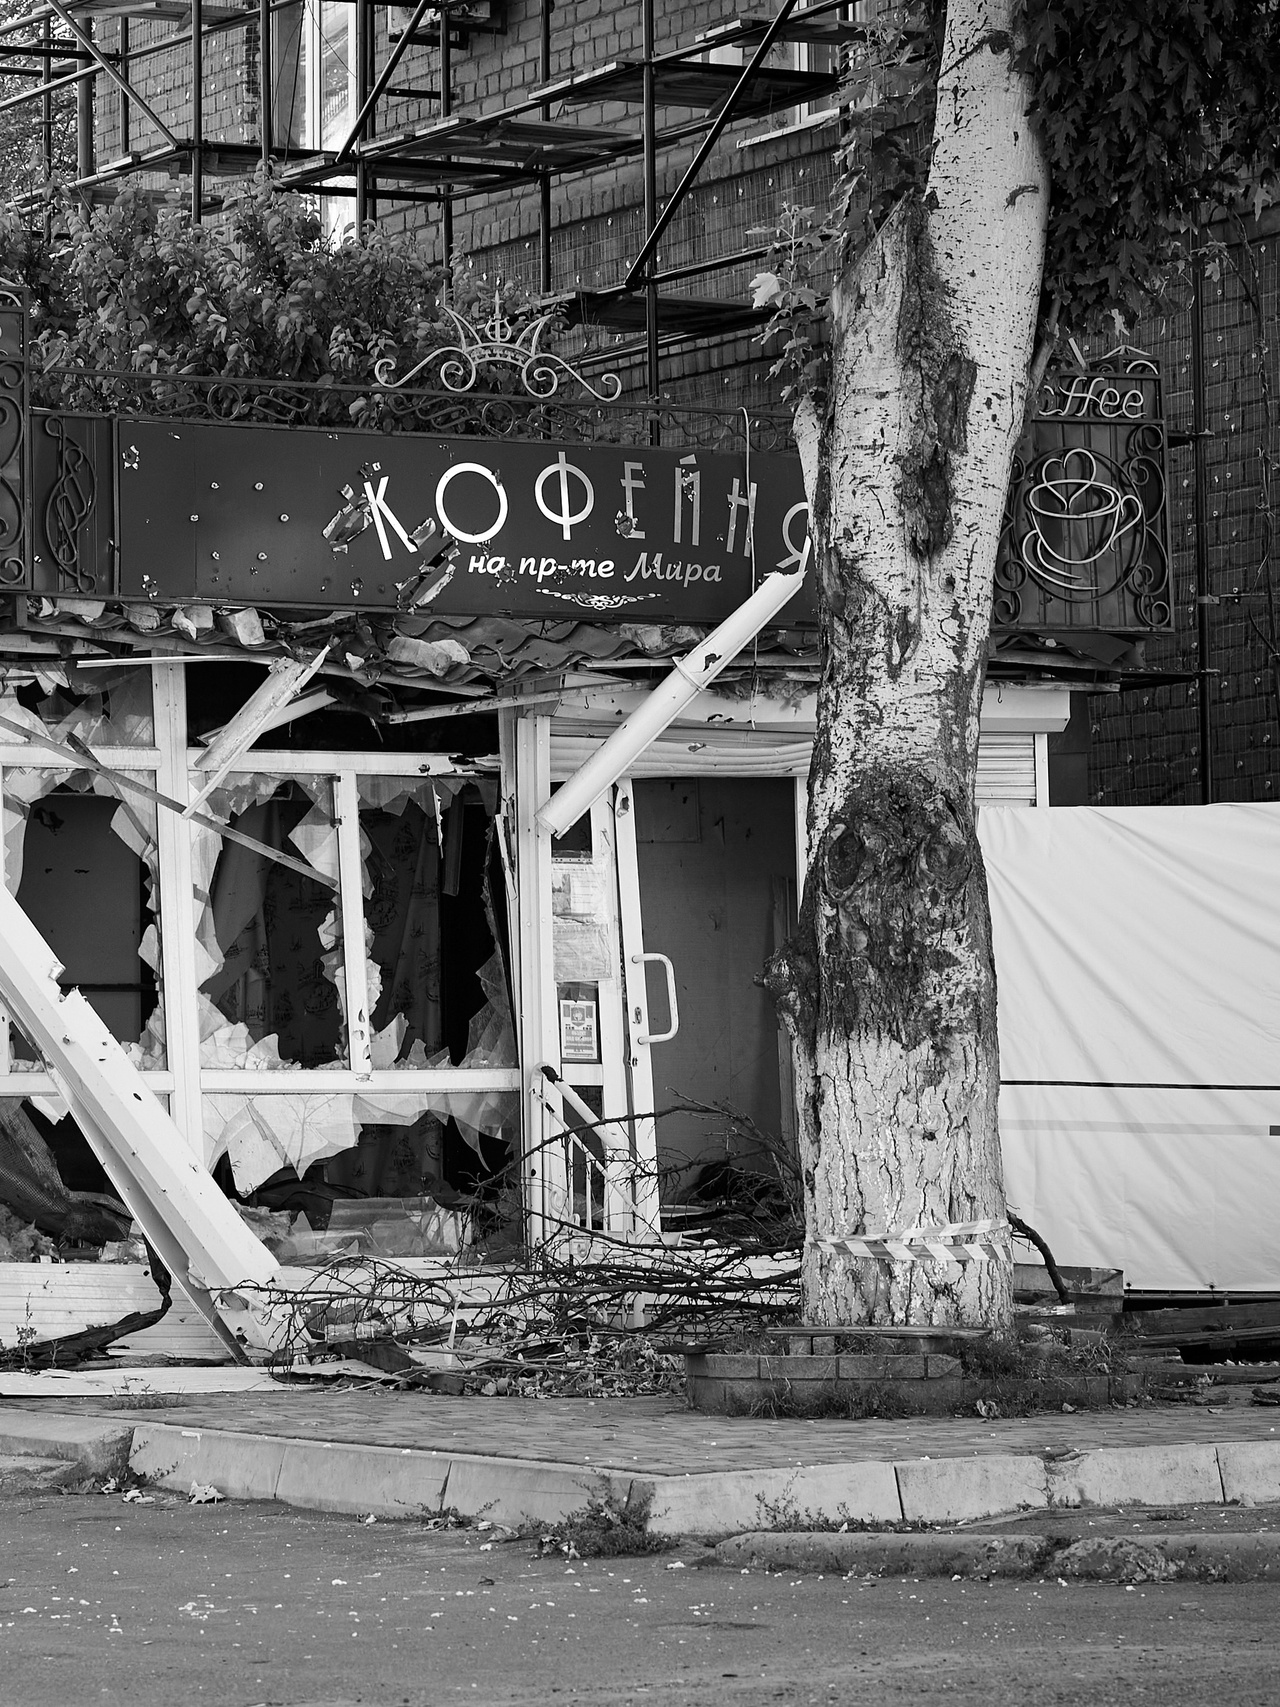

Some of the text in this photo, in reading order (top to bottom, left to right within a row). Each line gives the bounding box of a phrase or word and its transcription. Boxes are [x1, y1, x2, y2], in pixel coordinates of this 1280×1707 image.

[363, 451, 812, 574] КОФЕЙНЯ
[468, 552, 723, 588] на пр-те Мира
